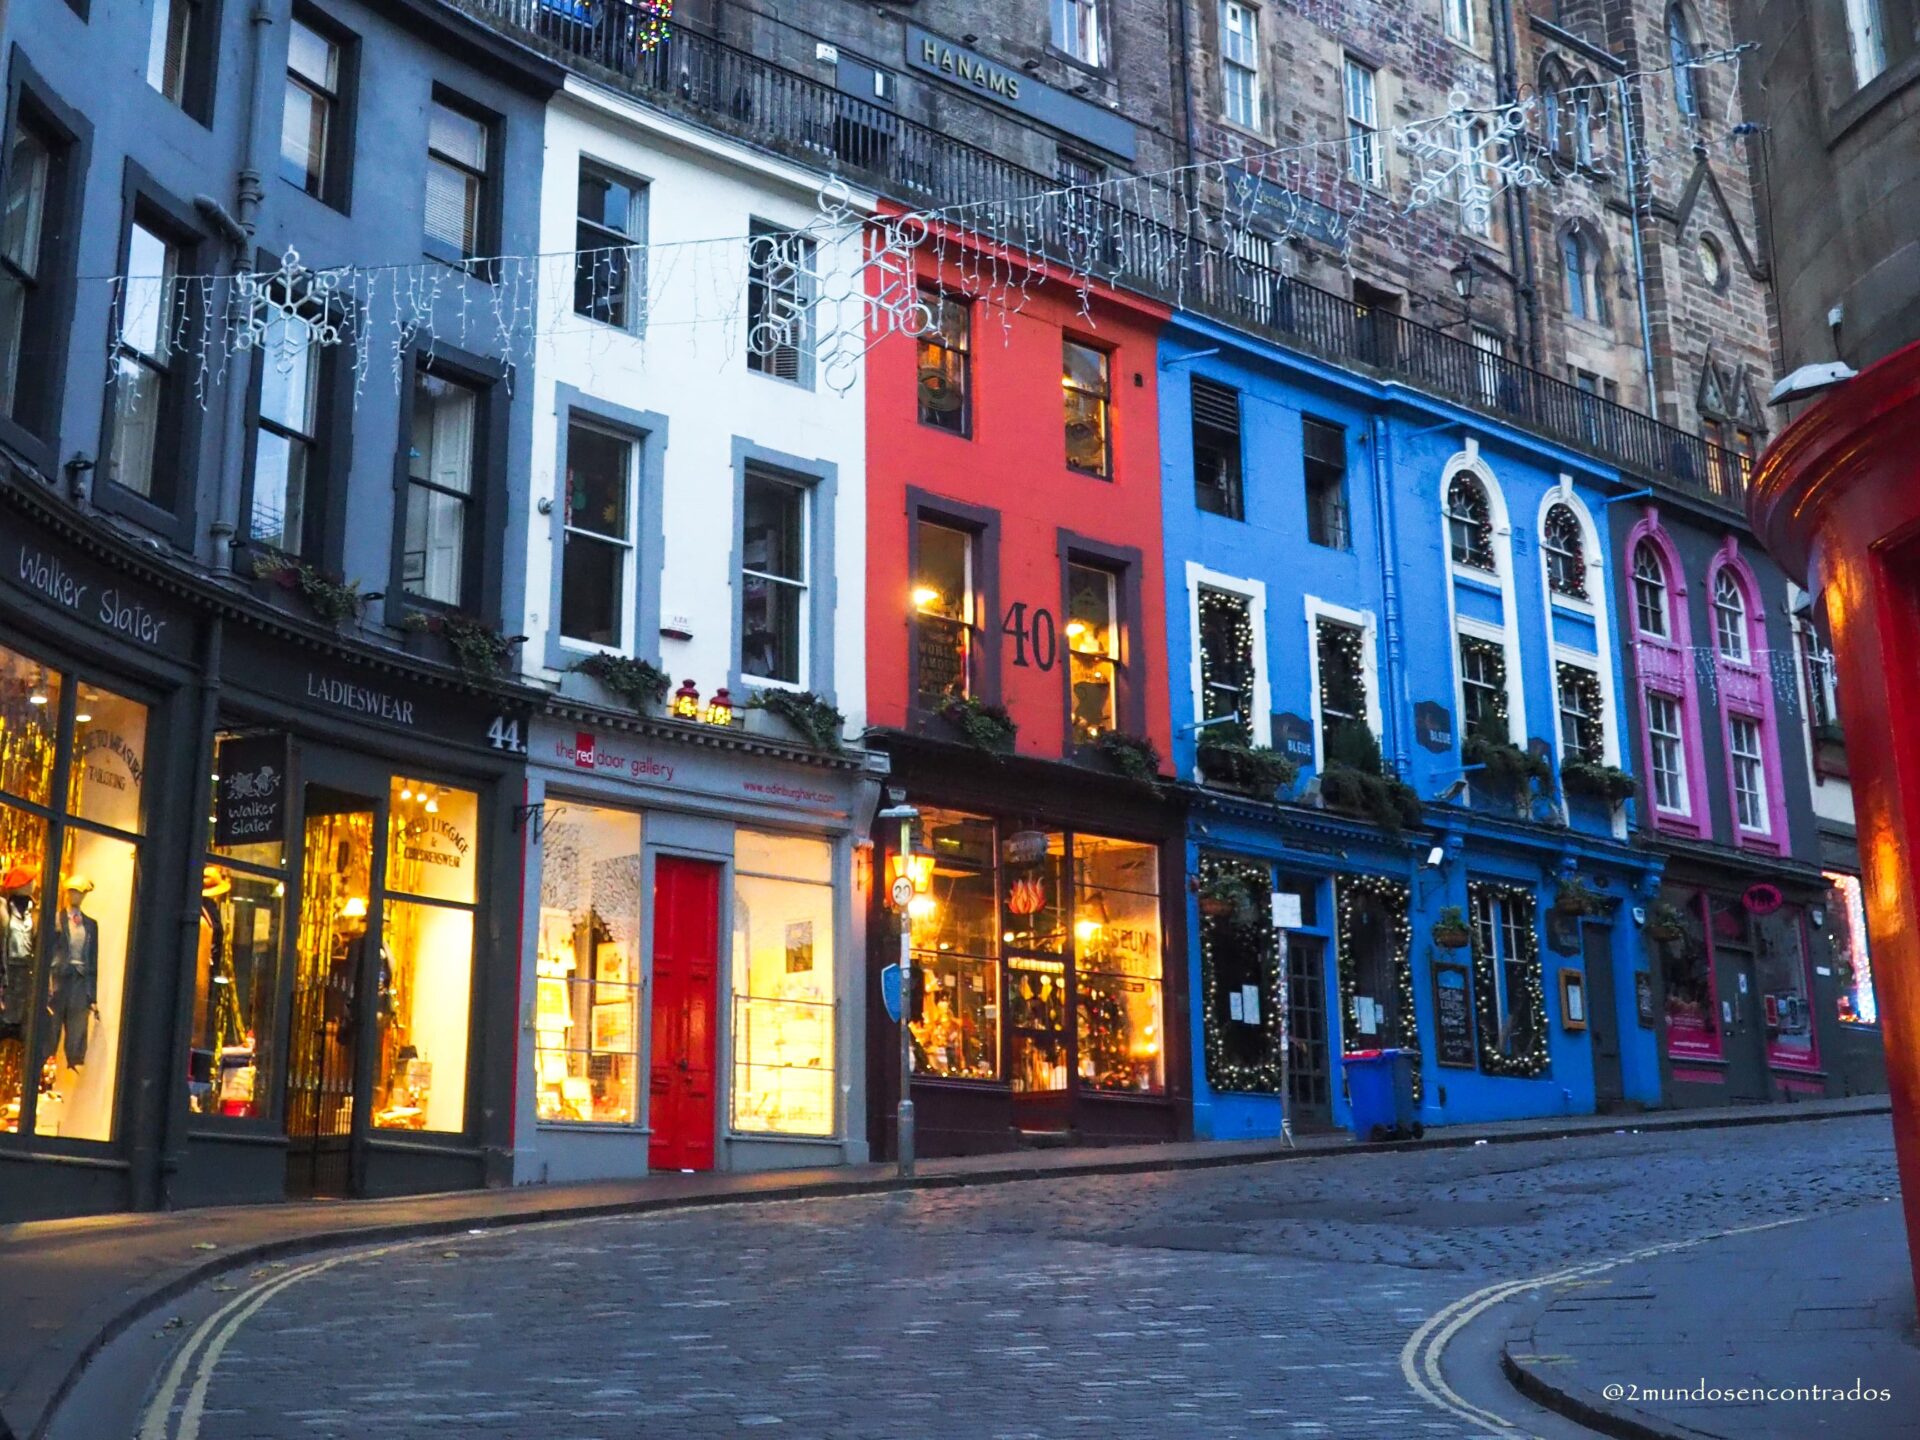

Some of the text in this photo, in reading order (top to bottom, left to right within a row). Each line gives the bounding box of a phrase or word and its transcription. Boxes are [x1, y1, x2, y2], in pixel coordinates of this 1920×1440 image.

[921, 38, 1021, 101] HANAMS
[20, 545, 168, 645] Walker Slater
[1002, 602, 1056, 672] 40
[307, 672, 414, 724] LADIESWEAR
[555, 739, 674, 781] the red door gallery
[895, 884, 912, 899] 20
